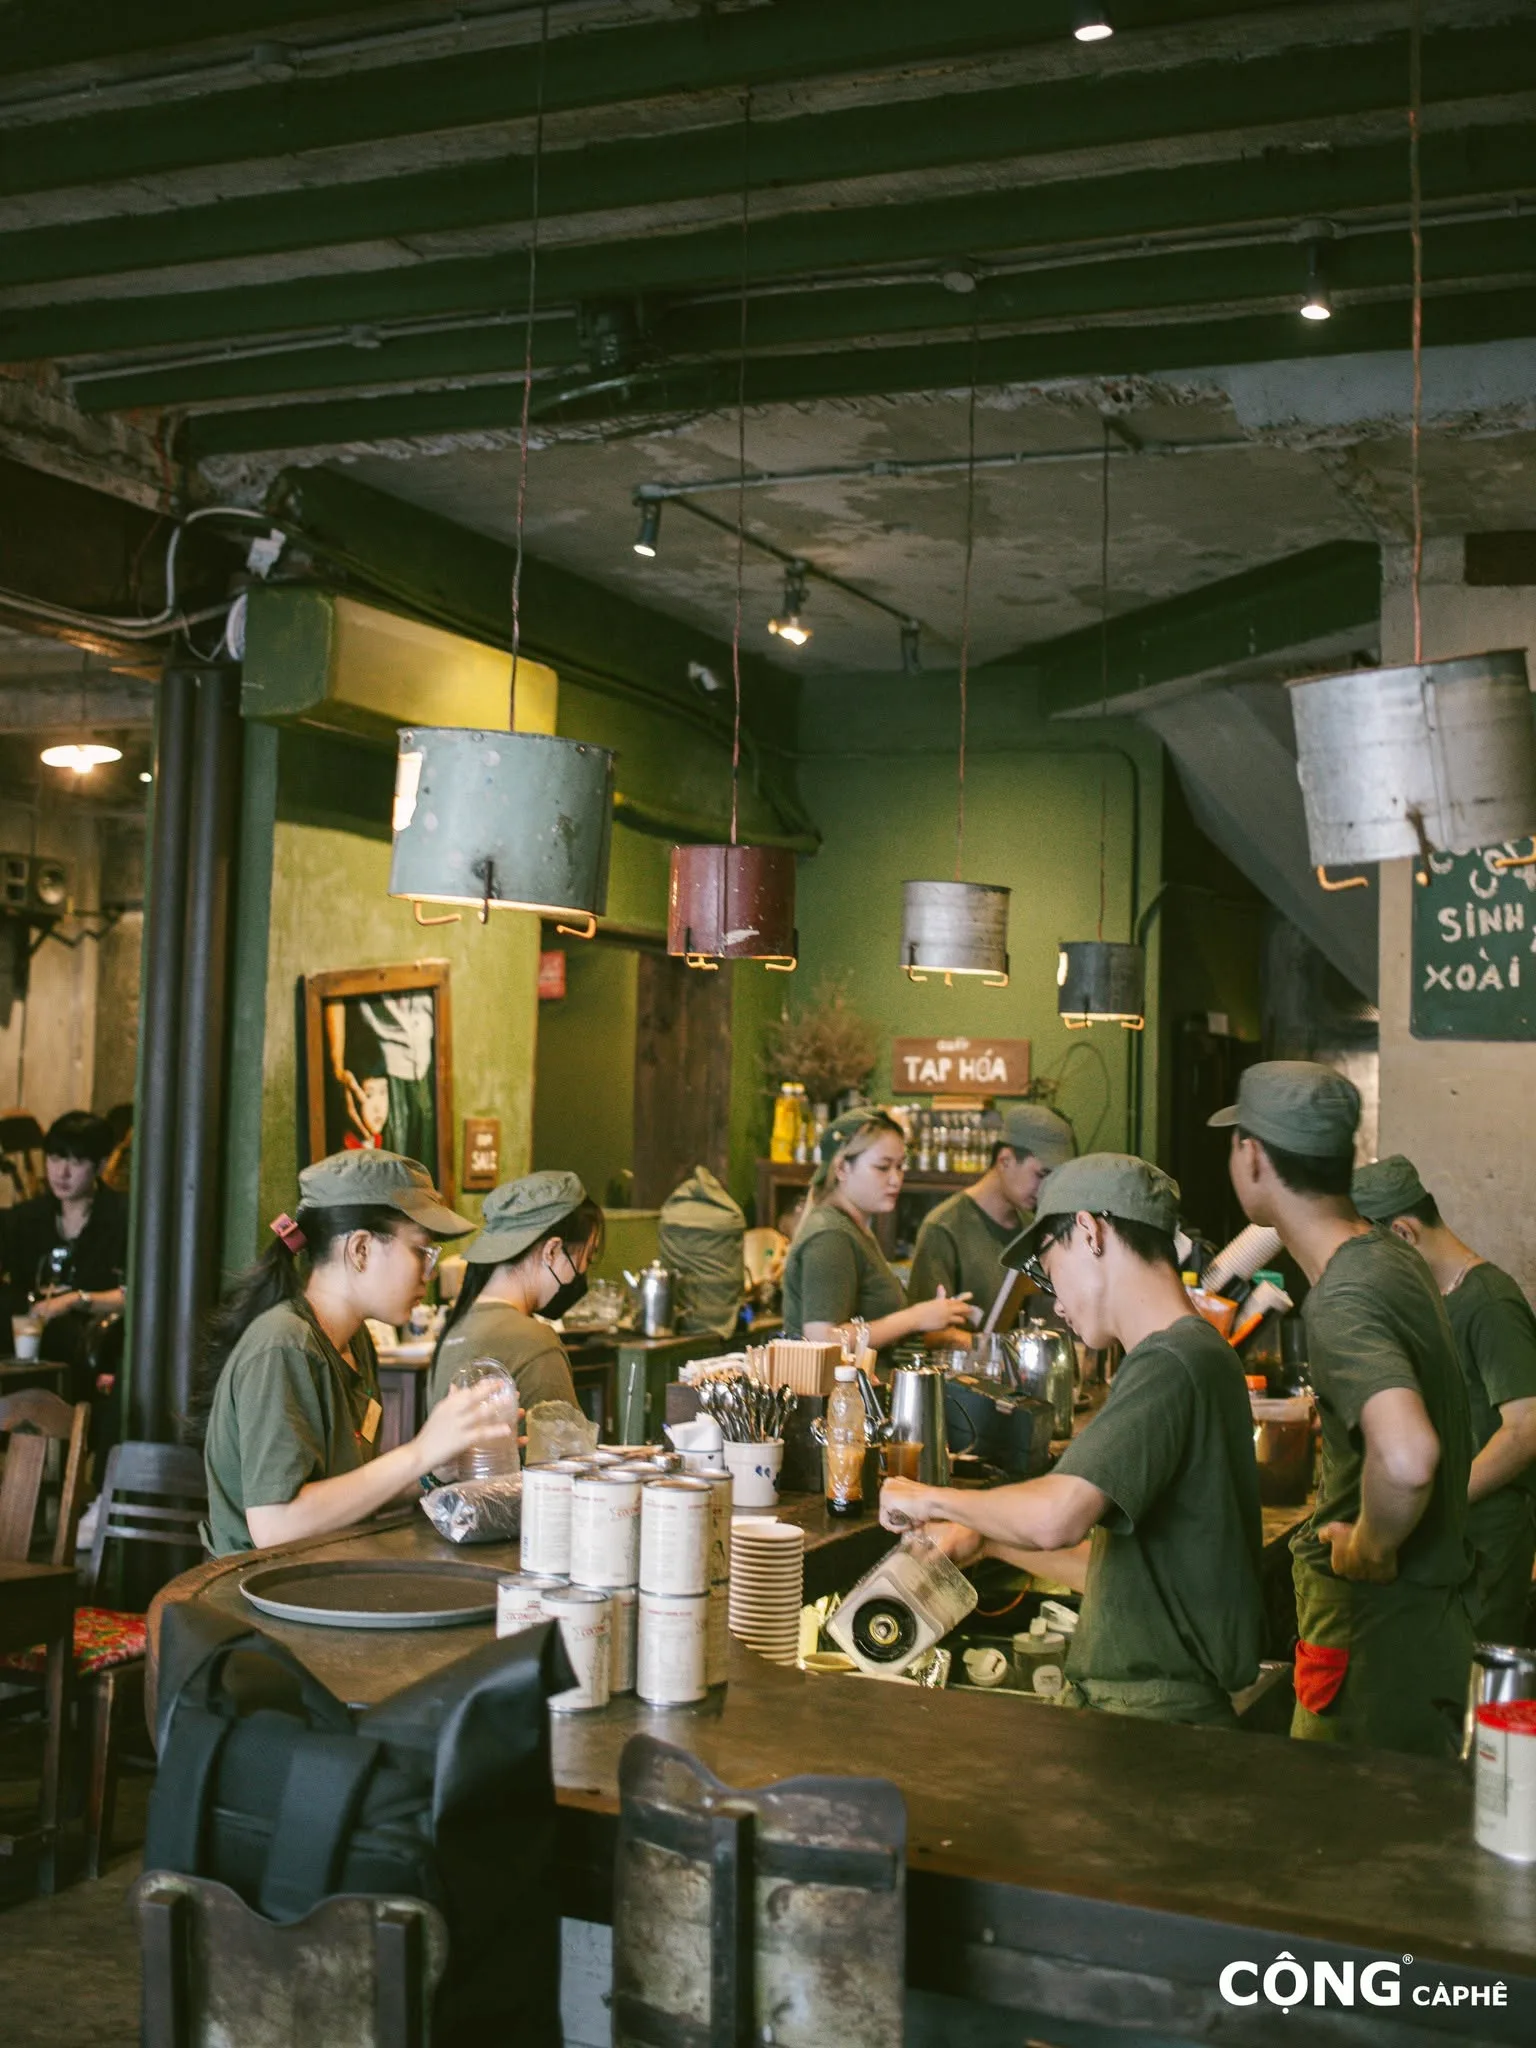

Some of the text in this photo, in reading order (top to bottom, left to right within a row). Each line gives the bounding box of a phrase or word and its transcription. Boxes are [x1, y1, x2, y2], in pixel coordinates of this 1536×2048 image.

[1423, 947, 1521, 992] XOÀI
[903, 1048, 1008, 1086] TẠP HÓA
